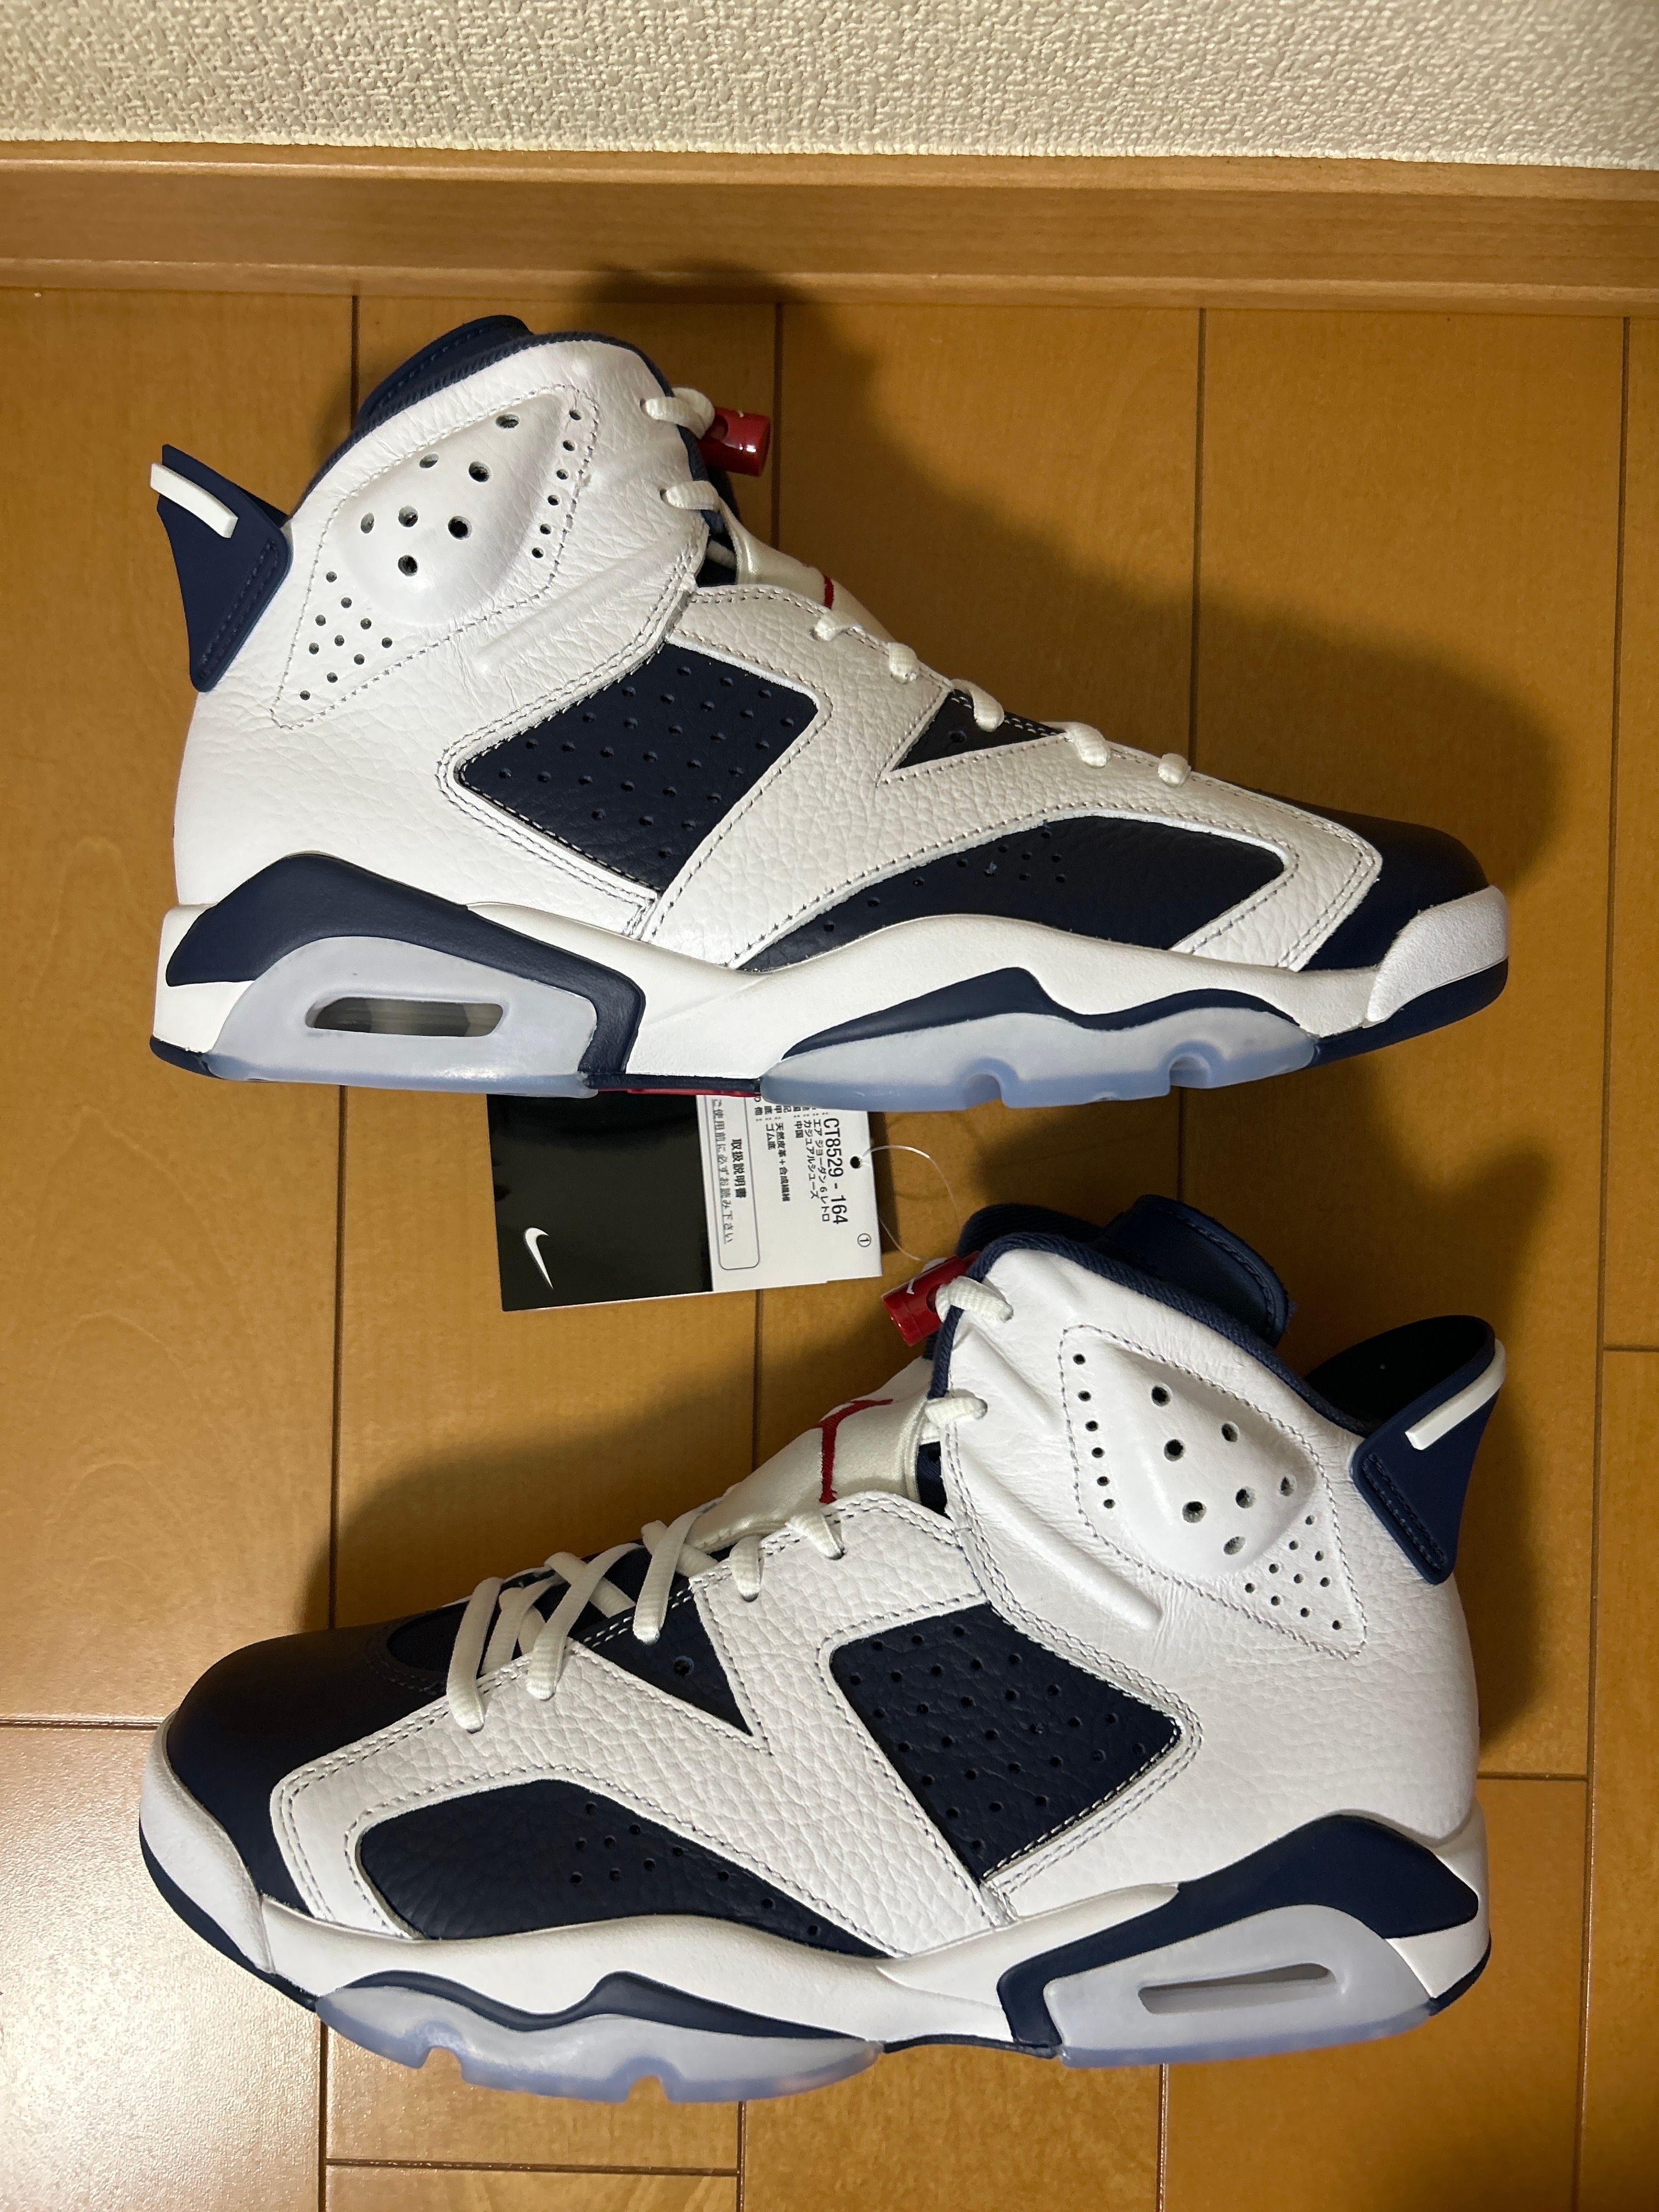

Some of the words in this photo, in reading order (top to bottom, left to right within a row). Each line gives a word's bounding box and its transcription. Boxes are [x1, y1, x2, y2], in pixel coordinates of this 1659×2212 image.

[766, 1123, 776, 1150] ゴム底
[794, 1121, 804, 1138] 中国
[823, 1118, 844, 1177] CT8529
[713, 1098, 733, 1243] ご使用前に必ずお読み下さい
[731, 1138, 747, 1199] 取扱説明書
[803, 1120, 819, 1199] カジュアルシューズ
[831, 1195, 848, 1224] 164
